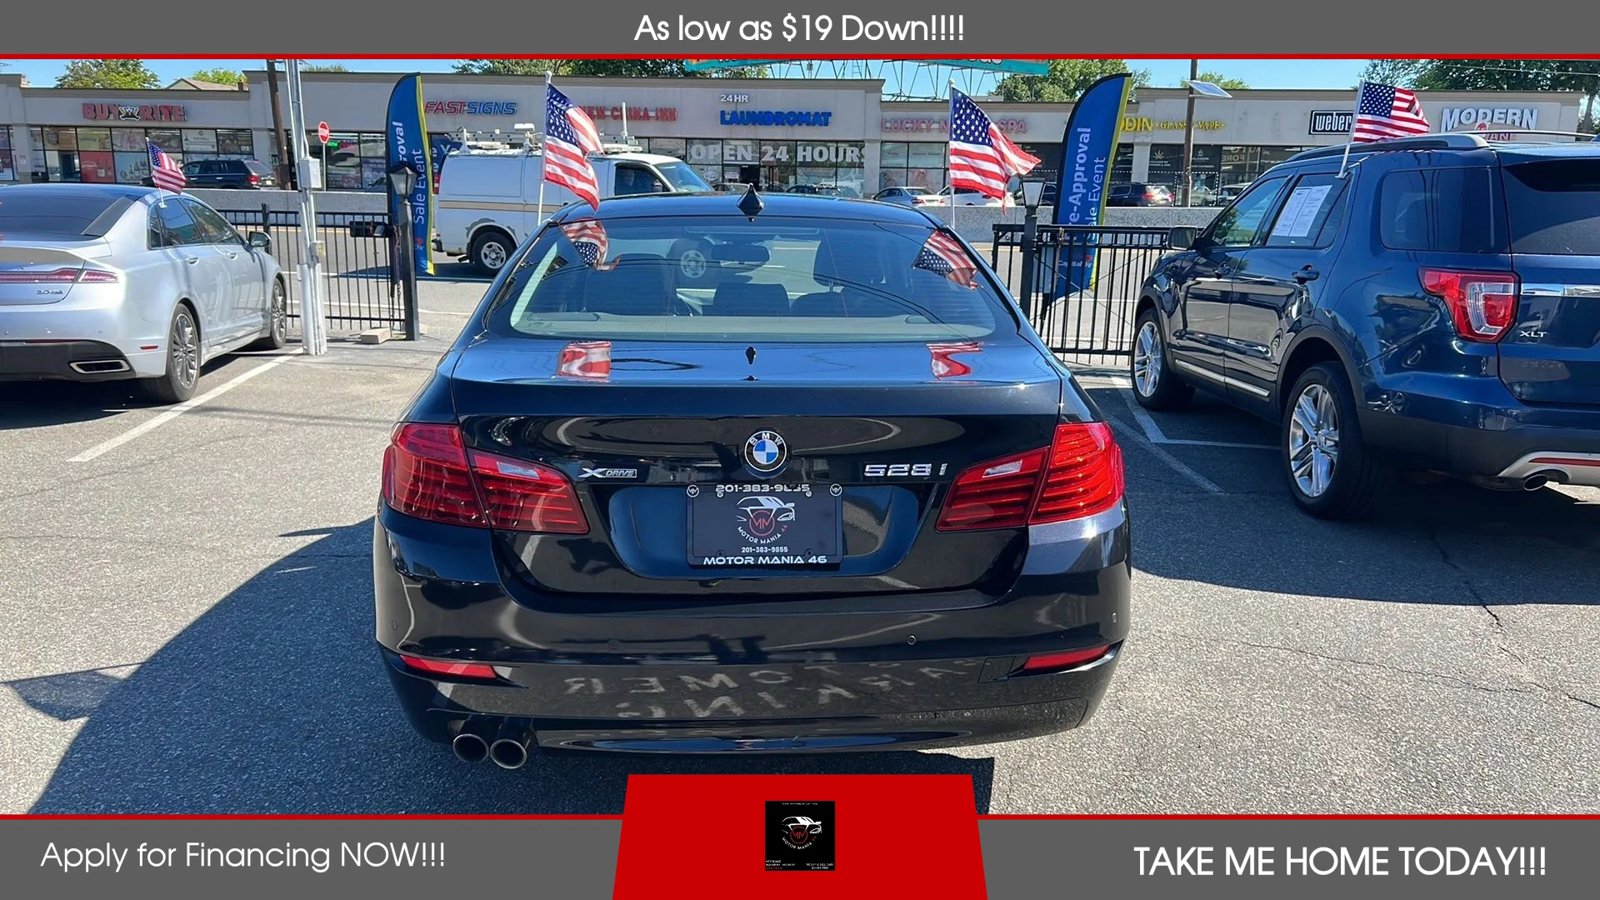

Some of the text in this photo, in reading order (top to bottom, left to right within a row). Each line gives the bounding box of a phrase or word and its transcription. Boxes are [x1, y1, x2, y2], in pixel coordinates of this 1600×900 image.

[82, 103, 185, 121] BUY RITE
[424, 101, 518, 115] FASTSIGNS
[655, 107, 677, 121] INN
[720, 110, 832, 126] LAUNDROMAT
[881, 118, 937, 133] LUCKY
[997, 119, 1027, 133] SPA
[1441, 108, 1538, 133] MODERN
[690, 144, 751, 161] OPEN
[761, 146, 790, 162] 24
[412, 149, 426, 224] Sale Event
[1088, 157, 1106, 202] Event
[749, 431, 784, 447] BMW
[737, 526, 758, 544] MOTOR
[760, 533, 782, 544] MANIA
[703, 556, 828, 565] MOTOR MANIA 46
